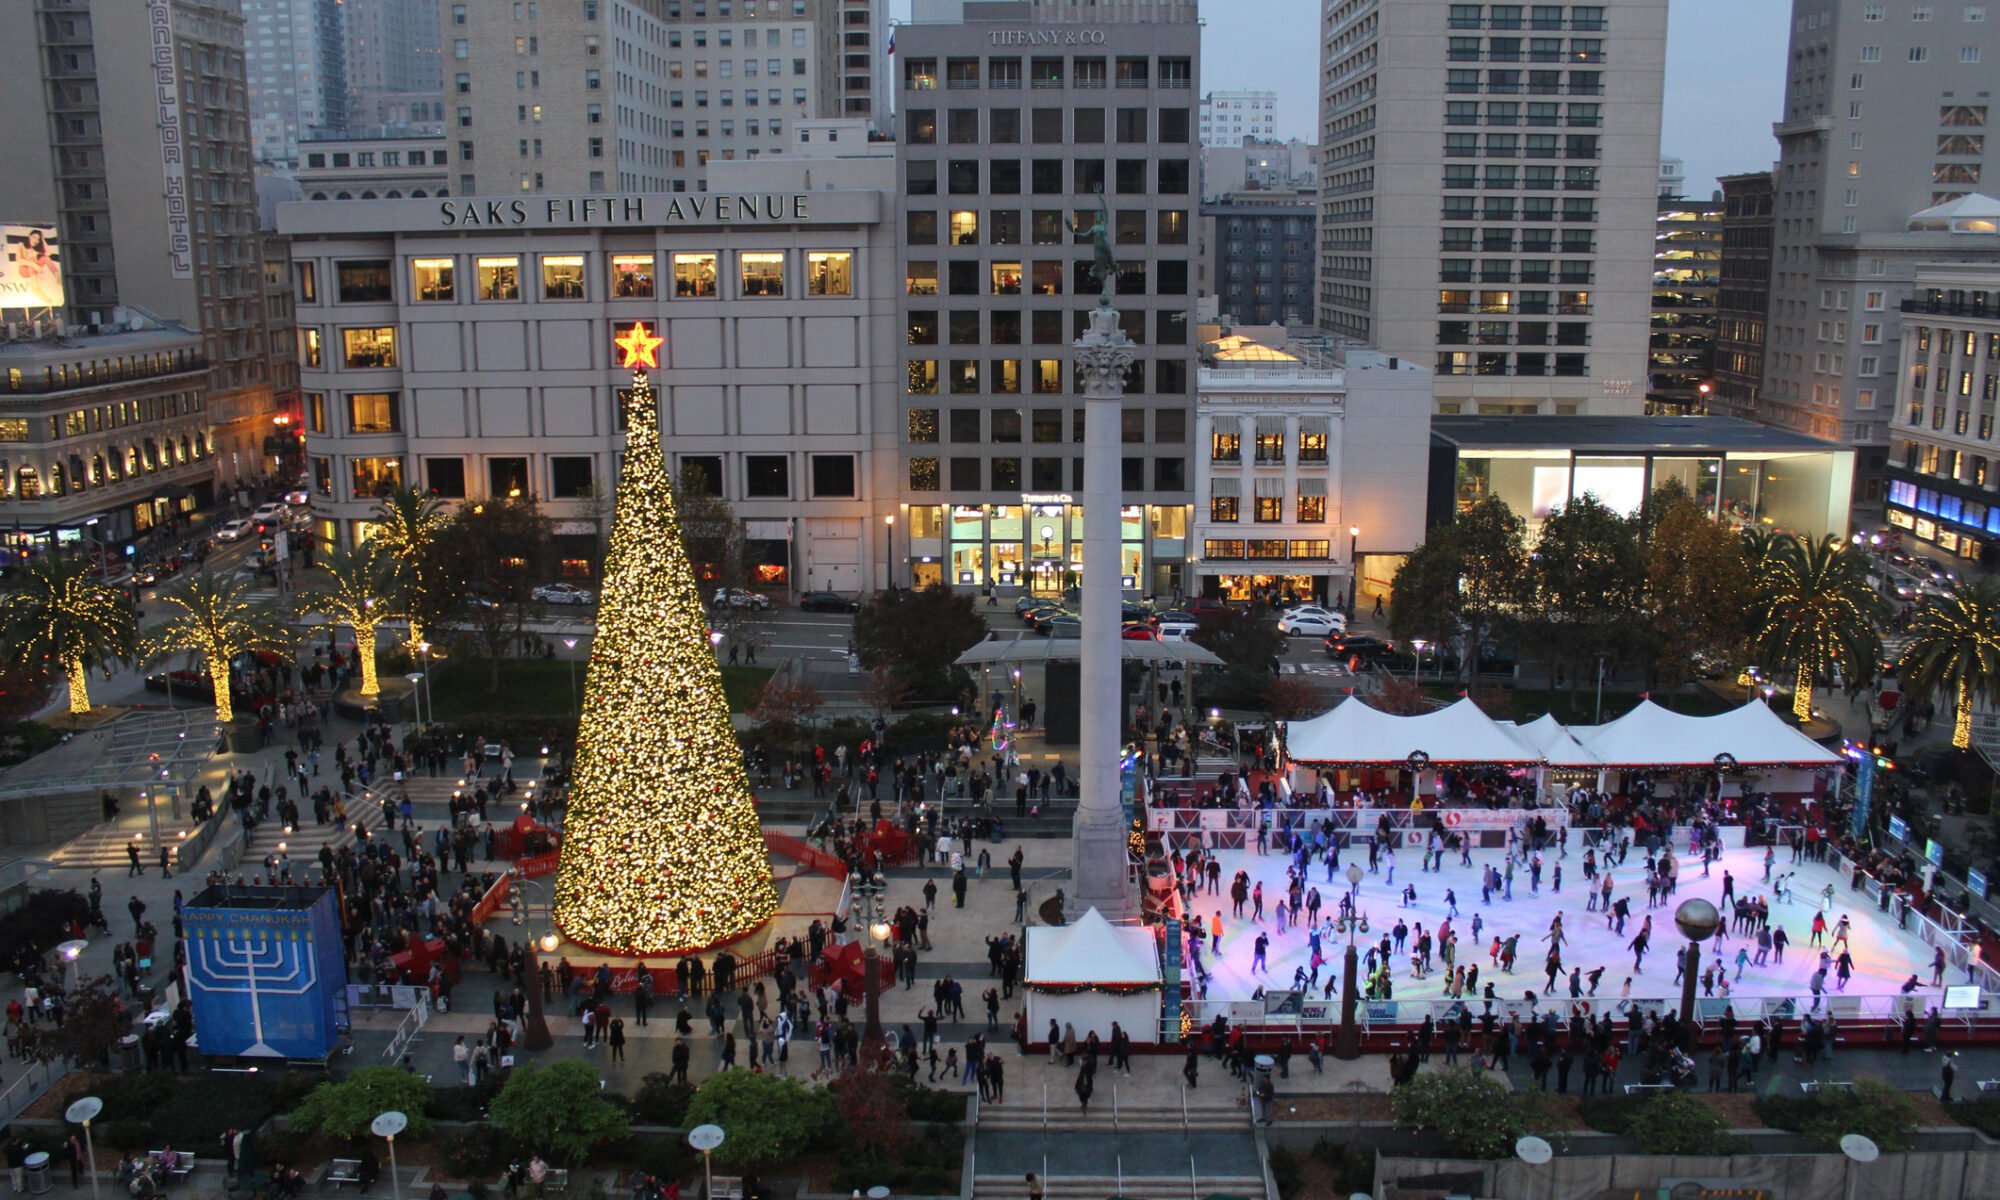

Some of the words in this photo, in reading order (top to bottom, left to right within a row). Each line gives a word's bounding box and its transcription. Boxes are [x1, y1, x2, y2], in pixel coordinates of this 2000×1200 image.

[988, 31, 1062, 46] TIFFANY
[1065, 31, 1077, 45] &
[1080, 30, 1107, 45] CO.
[151, 0, 181, 164] ANCELLOR
[166, 176, 190, 271] HOTEL
[441, 199, 528, 226] SAKS
[547, 198, 645, 222] FIFTH
[666, 194, 810, 221] AVENUE
[180, 911, 225, 921] HAPPY
[230, 912, 312, 923] CHANUKAH
